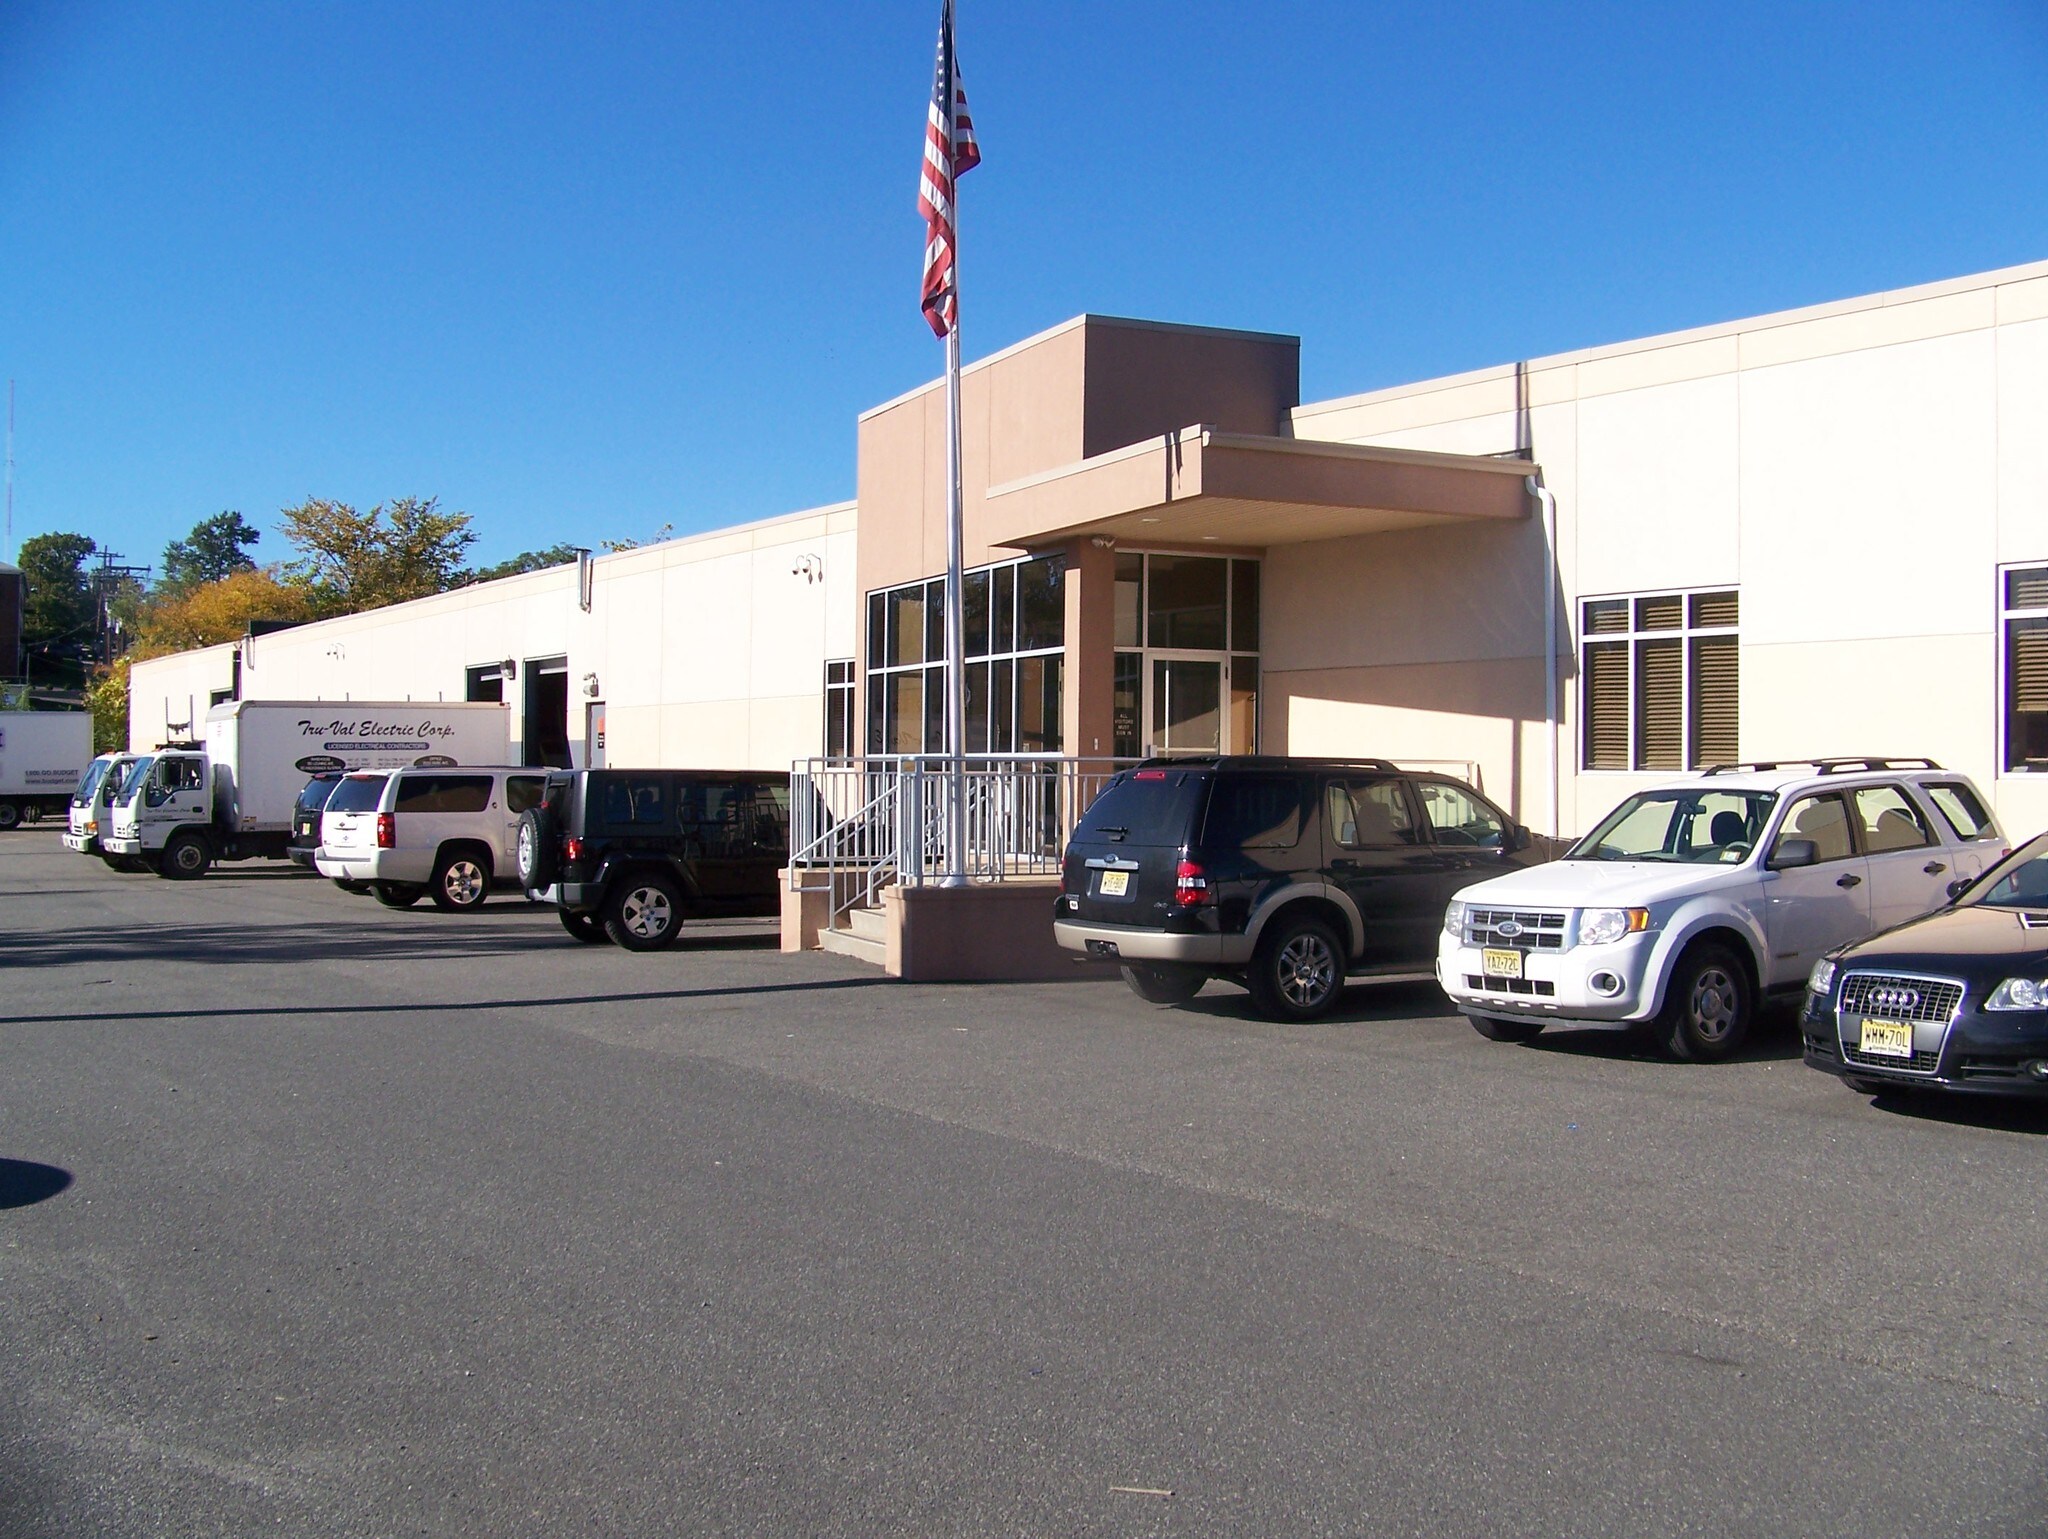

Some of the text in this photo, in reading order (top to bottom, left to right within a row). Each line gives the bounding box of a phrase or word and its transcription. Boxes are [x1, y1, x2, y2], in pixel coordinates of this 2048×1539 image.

[297, 720, 456, 739] Tru-Val Electric Corp.
